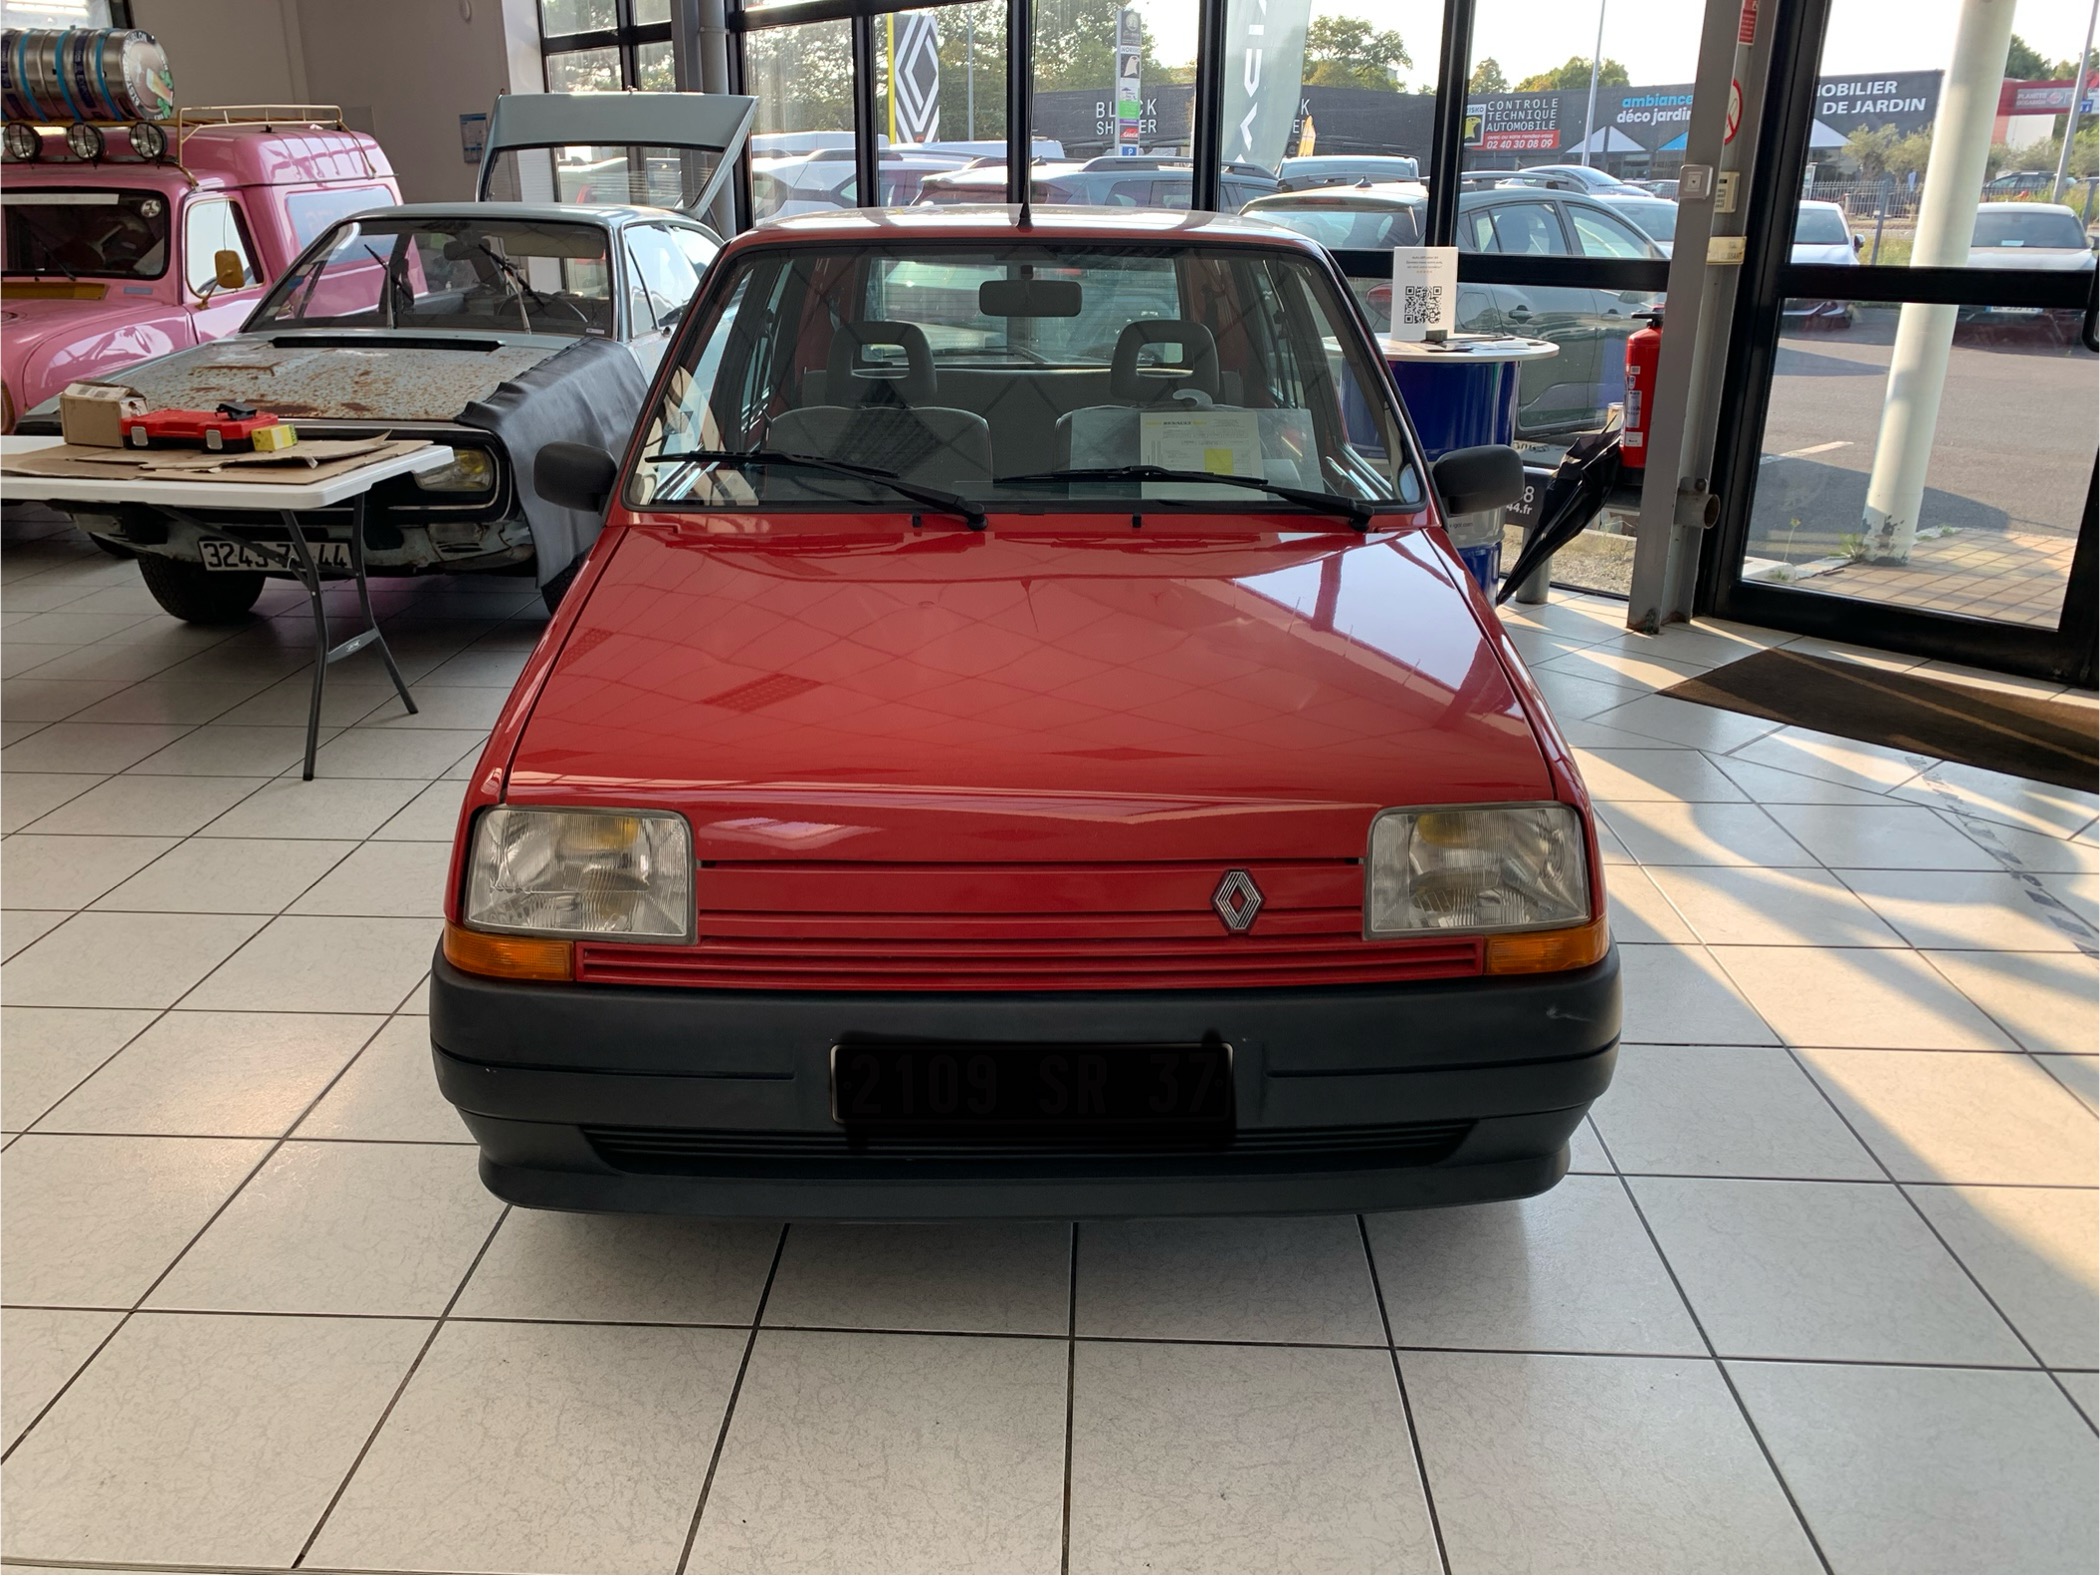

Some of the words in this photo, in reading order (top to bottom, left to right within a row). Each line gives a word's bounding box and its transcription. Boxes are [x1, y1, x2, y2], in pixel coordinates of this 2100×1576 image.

[1488, 98, 1559, 111] CONTROLE
[1622, 93, 1693, 108] ambiance
[1822, 101, 1849, 115] DE
[1851, 98, 1926, 114] JARDIN
[1096, 99, 1157, 119] BLK
[1467, 105, 1484, 113] ISKO
[1488, 109, 1557, 121] TECHNIQUE
[1617, 109, 1651, 123] déco
[1096, 119, 1157, 136] SHER
[1486, 120, 1556, 132] AUTOMOBILE
[1487, 141, 1498, 149] 02
[1500, 140, 1512, 149] 40
[1514, 140, 1526, 148] 30
[1541, 139, 1553, 148] 09
[318, 544, 347, 569] 44
[851, 1053, 997, 1115] 2109
[1039, 1054, 1107, 1115] SR
[1149, 1053, 1219, 1114] 37
